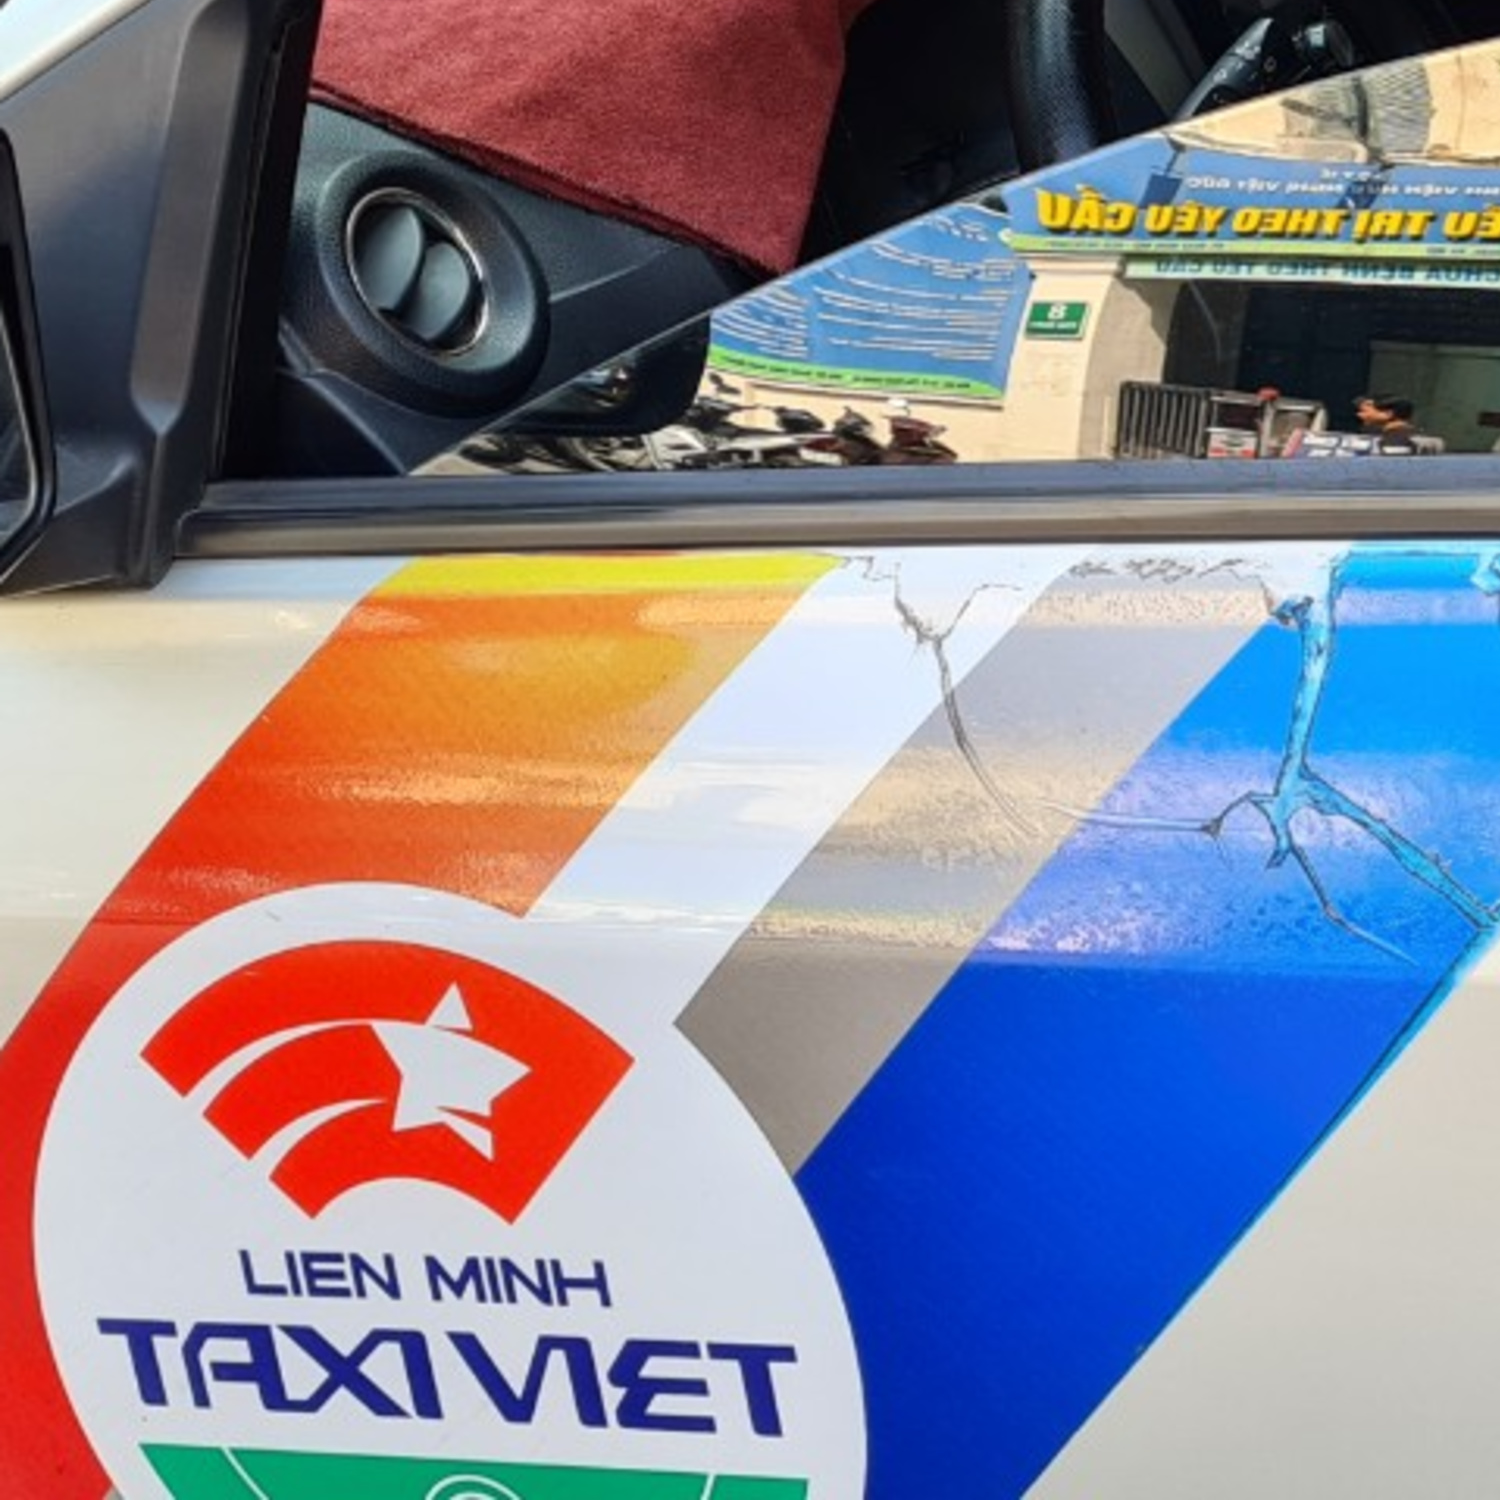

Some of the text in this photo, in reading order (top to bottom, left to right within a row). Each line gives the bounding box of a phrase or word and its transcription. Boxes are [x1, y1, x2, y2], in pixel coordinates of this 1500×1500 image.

[239, 1249, 613, 1307] LIEN MINH
[97, 1317, 798, 1438] TAXI VIET
